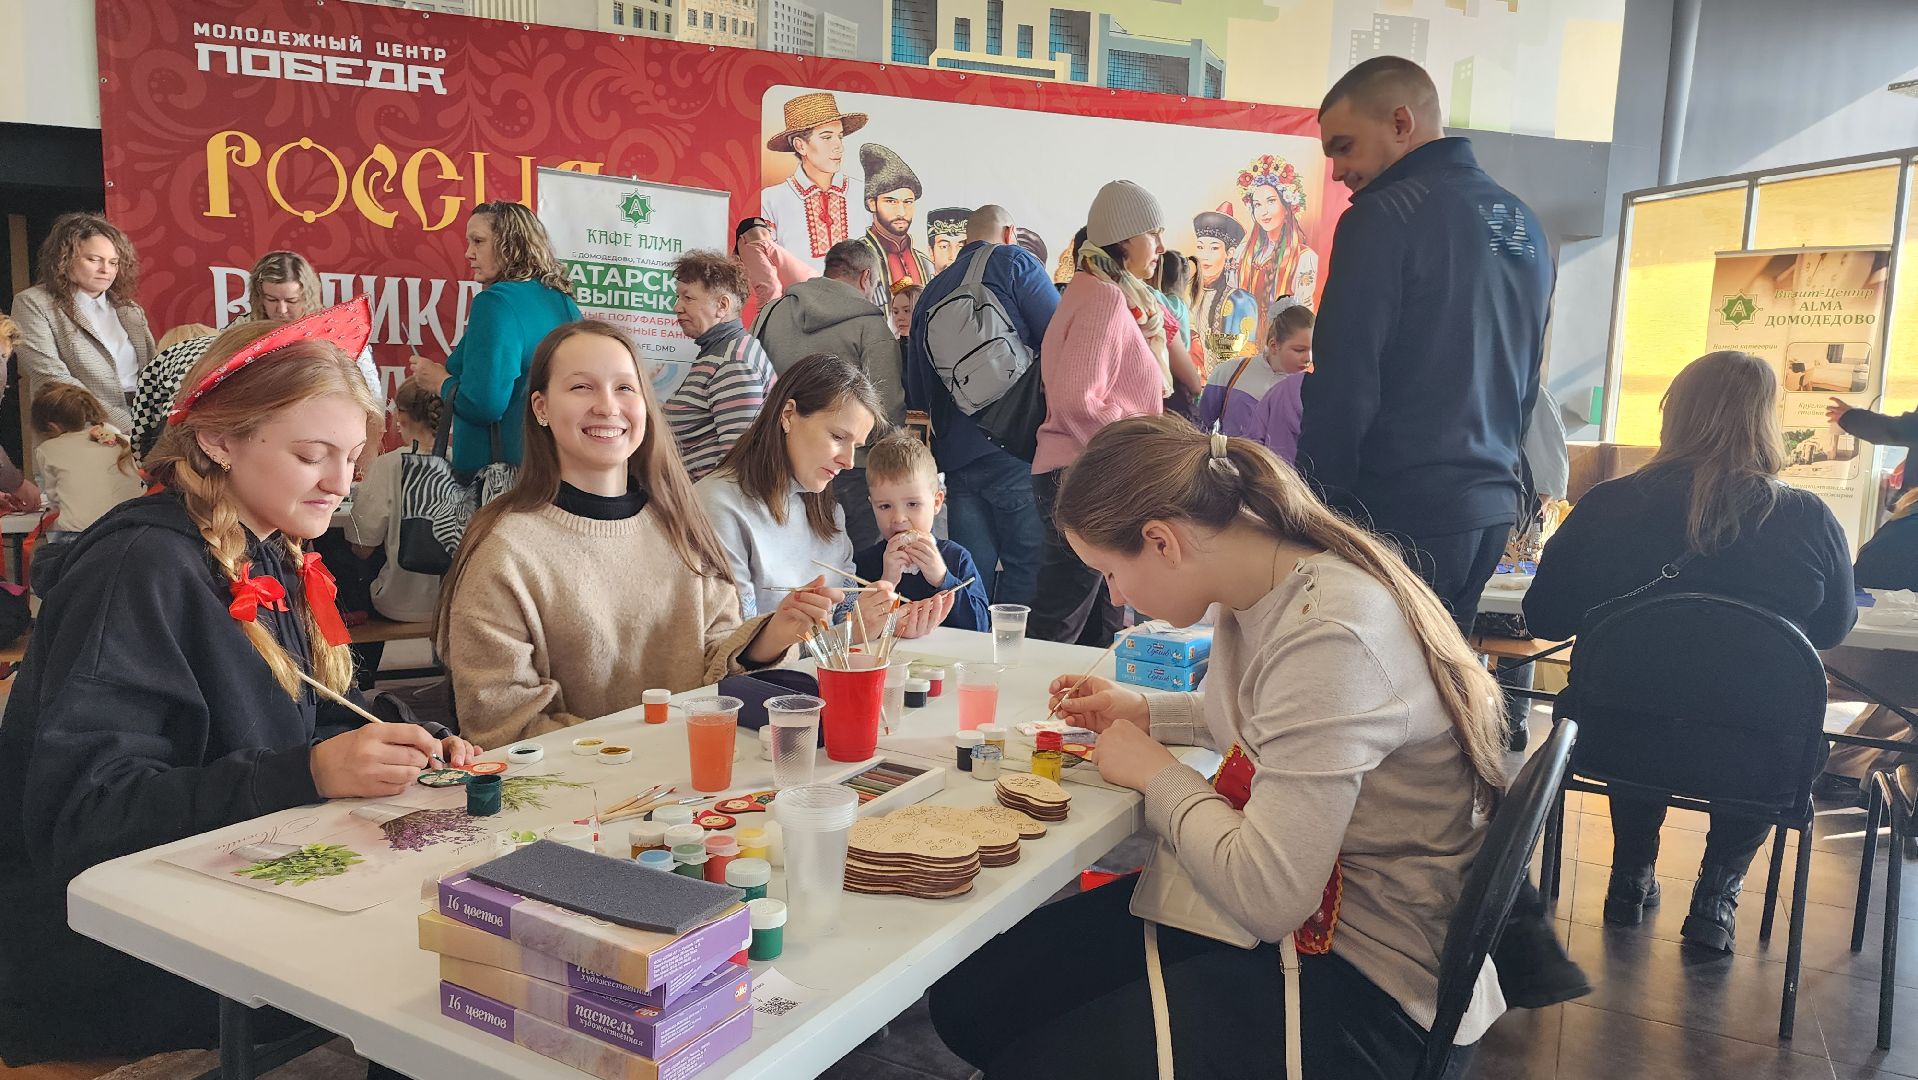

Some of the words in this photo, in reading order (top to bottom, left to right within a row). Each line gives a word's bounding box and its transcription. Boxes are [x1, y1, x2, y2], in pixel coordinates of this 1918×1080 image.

[193, 22, 362, 53] МОЛОДЕЖНЫЙ
[376, 41, 447, 61] ЦЕНТР
[194, 42, 448, 95] ПОБЕДА
[203, 130, 604, 231] РОССИ
[586, 228, 632, 247] КАФЕ
[639, 233, 683, 253] АЛМА
[562, 262, 678, 293] АТАРСК
[636, 257, 677, 268] ТАЛАЛИХ
[576, 287, 679, 311] ВЫПЕЧК
[1799, 301, 1843, 312] ALMA
[608, 313, 680, 327] ПОЛУФАБРИ
[1764, 314, 1876, 328] ДОМОДЕДОВО
[447, 894, 460, 911] 16
[463, 903, 504, 927] цветов
[448, 994, 461, 1011] 16
[465, 1004, 507, 1029] цветов
[575, 1004, 635, 1036] пастель
[579, 1018, 644, 1047] художественная
